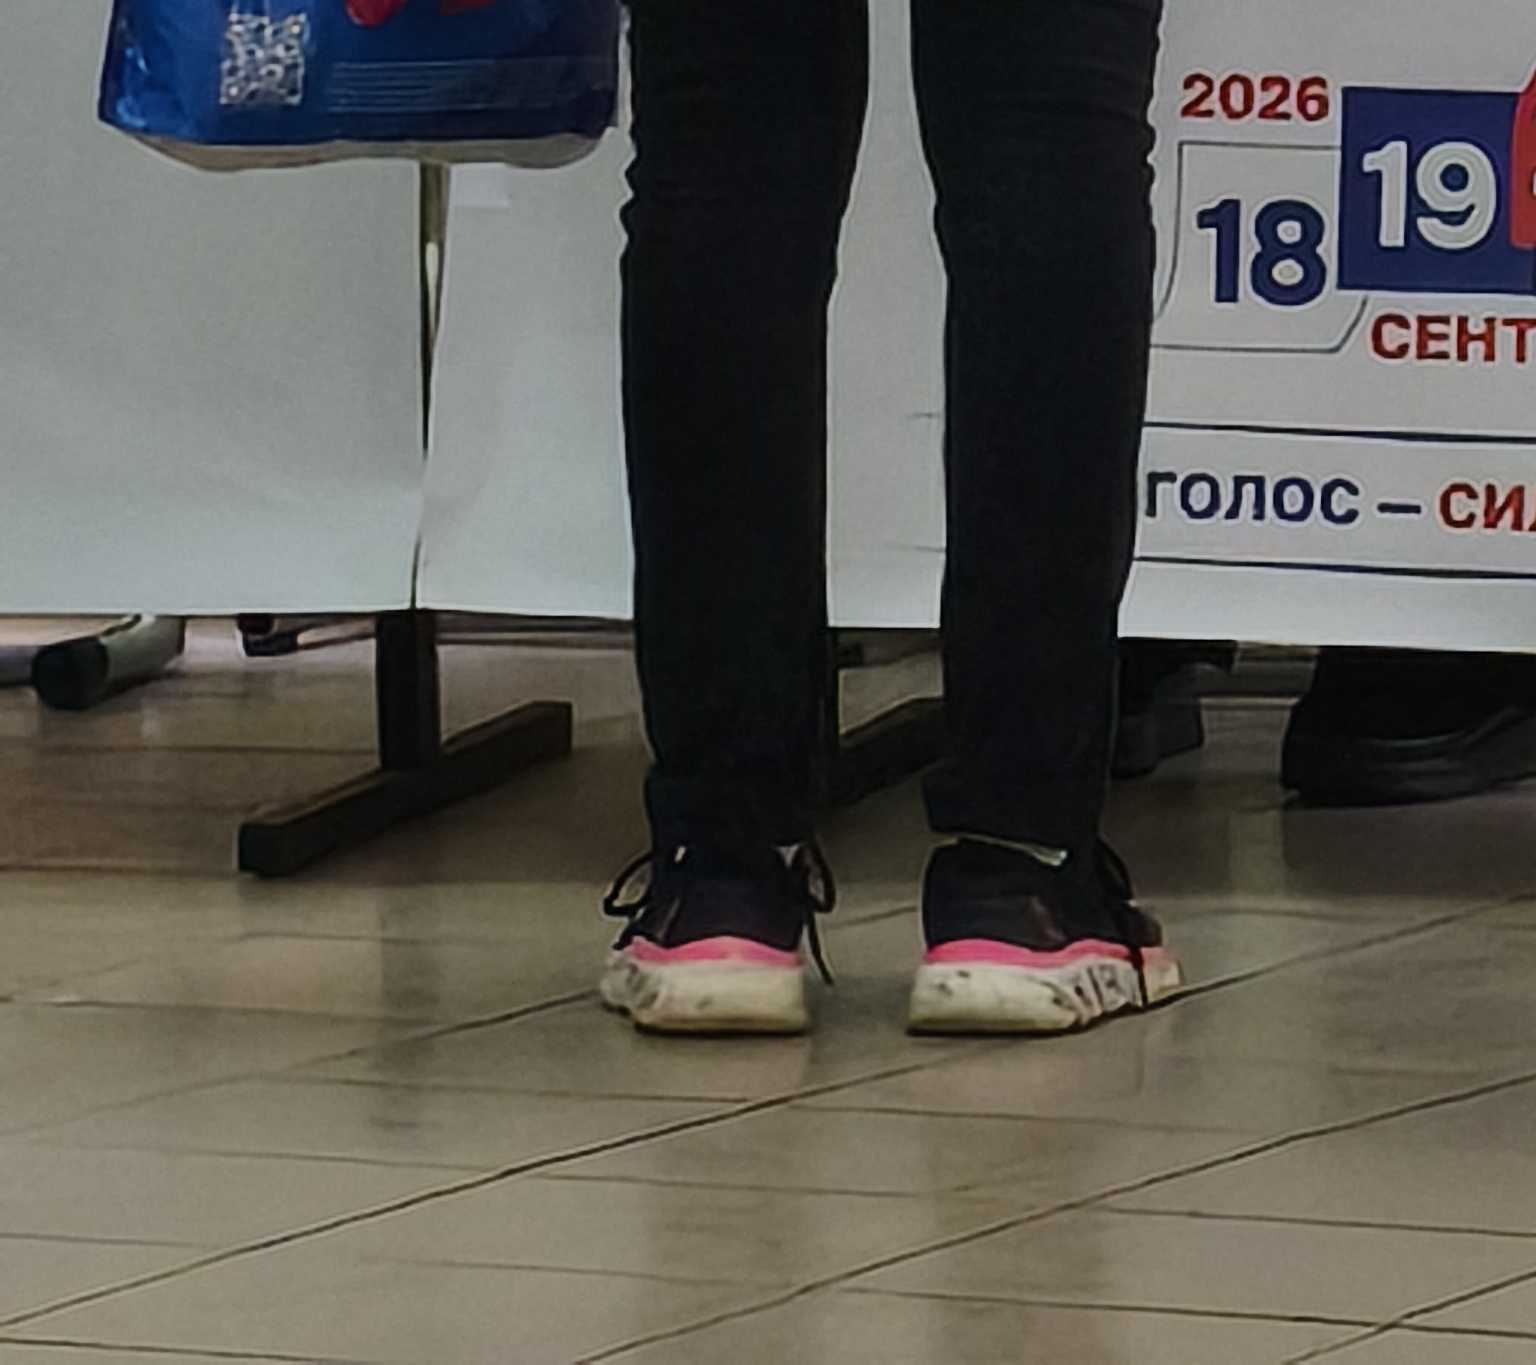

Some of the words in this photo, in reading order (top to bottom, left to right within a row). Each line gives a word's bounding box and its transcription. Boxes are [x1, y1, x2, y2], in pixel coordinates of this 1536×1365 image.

[1180, 72, 1330, 122] 2026
[1196, 198, 1328, 307] 18
[1362, 140, 1497, 249] 19
[1145, 470, 1360, 525] ГОЛОС
